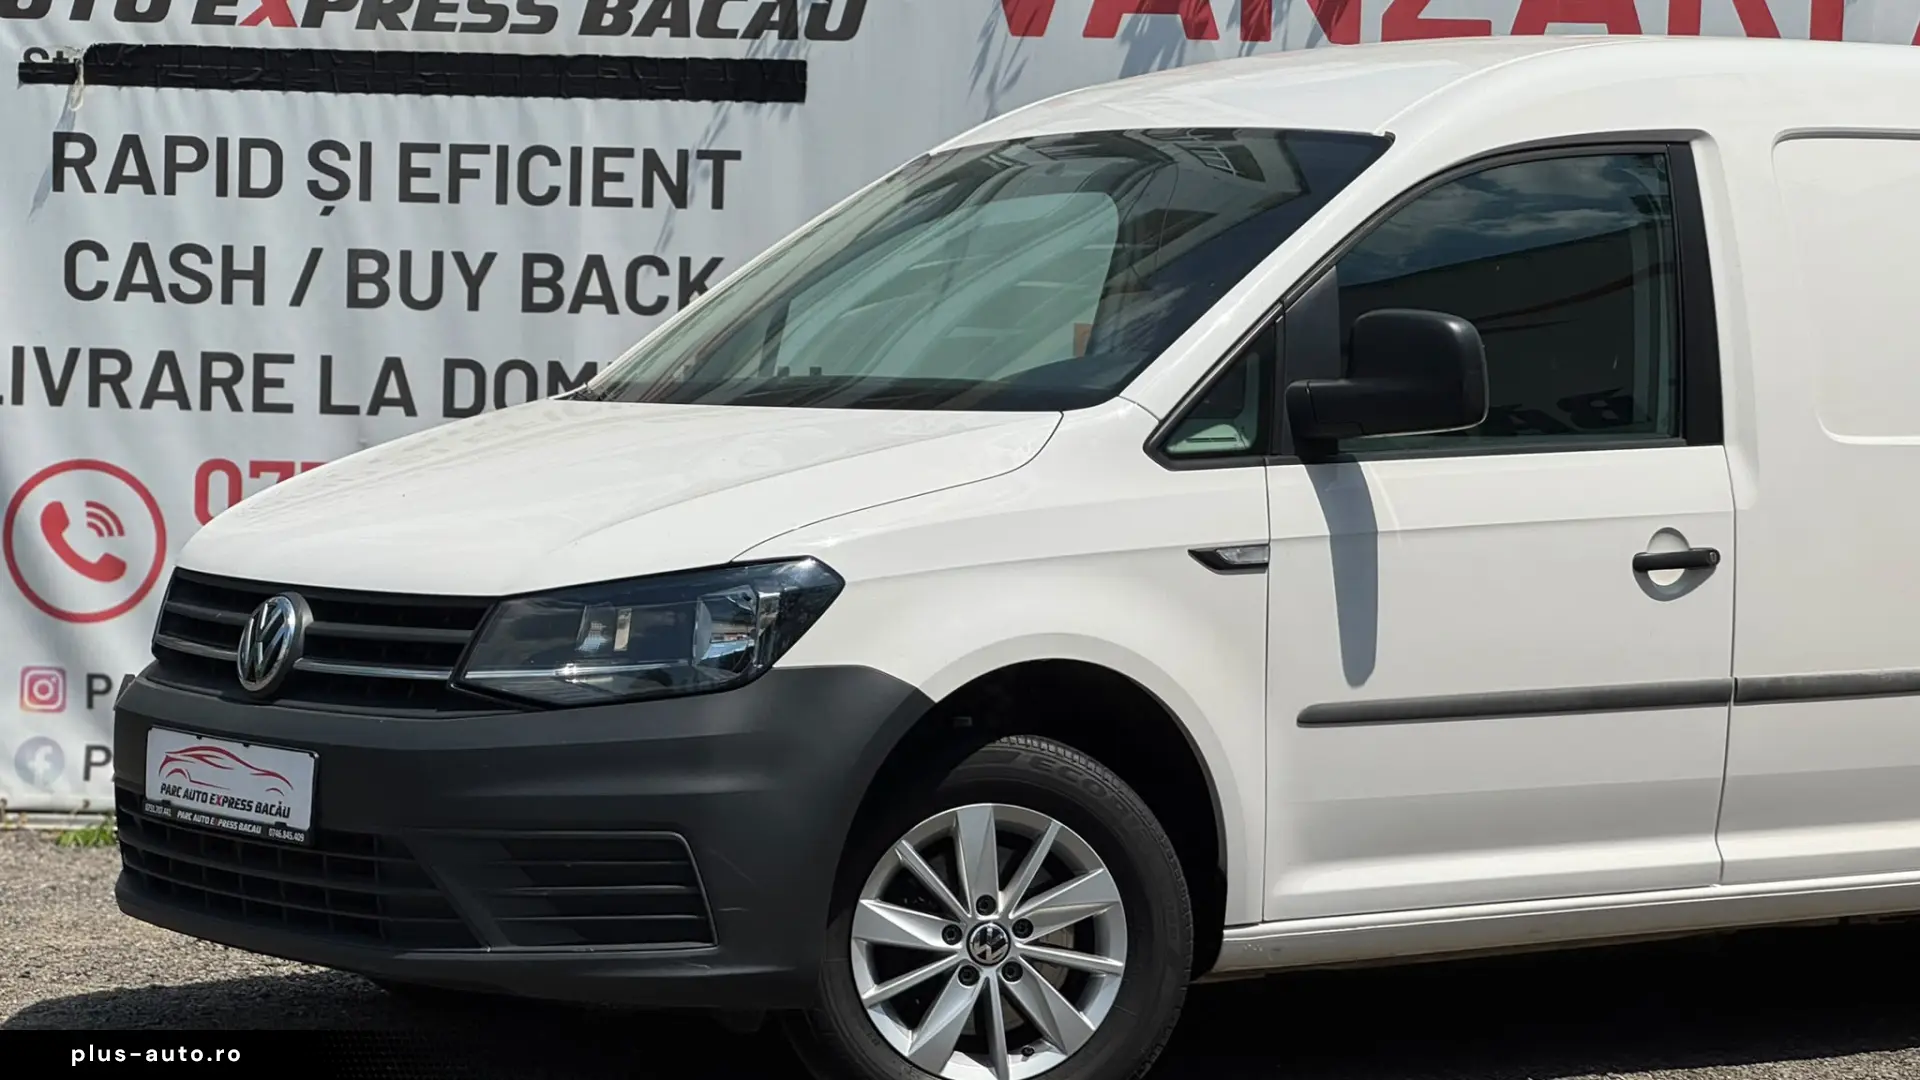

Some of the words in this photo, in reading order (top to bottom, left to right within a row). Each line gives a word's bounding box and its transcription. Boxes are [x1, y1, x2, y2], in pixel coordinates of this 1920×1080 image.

[52, 131, 284, 198] RAPID
[307, 139, 373, 217] ȘI
[399, 142, 742, 210] EFICIENT
[64, 239, 266, 305] CASH
[289, 247, 324, 307] /
[346, 248, 498, 312] BUY
[521, 252, 725, 317] BACK
[0, 345, 295, 414] IVRARE
[319, 354, 418, 417] LA
[160, 783, 183, 798] PARC
[183, 787, 208, 804] AUTO
[209, 794, 254, 812] EXPRESS
[177, 810, 193, 821] PARC
[192, 813, 210, 825] AUTO
